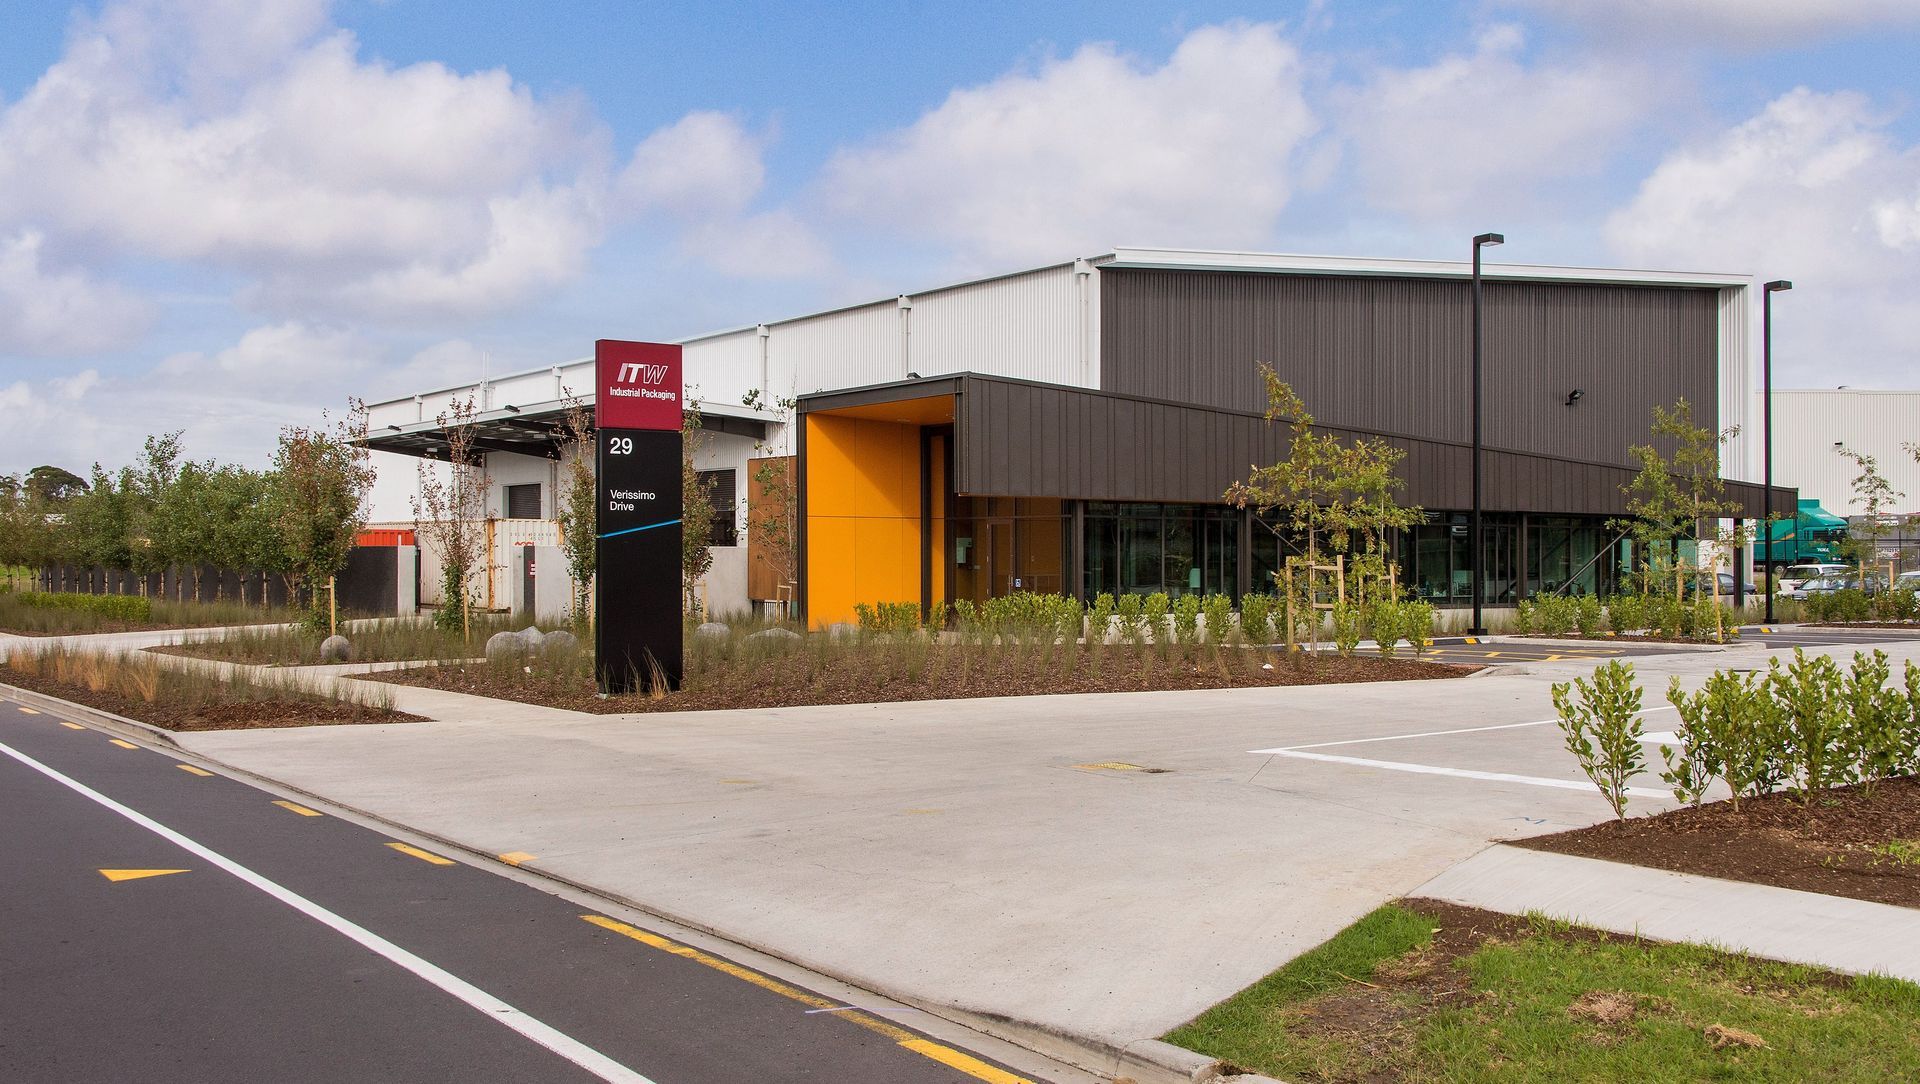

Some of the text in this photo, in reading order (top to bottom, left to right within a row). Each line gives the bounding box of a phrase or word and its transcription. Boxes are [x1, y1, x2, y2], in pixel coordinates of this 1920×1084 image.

[617, 362, 668, 385] ITW
[610, 386, 676, 401] Industrial Packaging
[610, 437, 633, 455] 29
[610, 489, 656, 500] Verissimo
[610, 501, 634, 511] Drive
